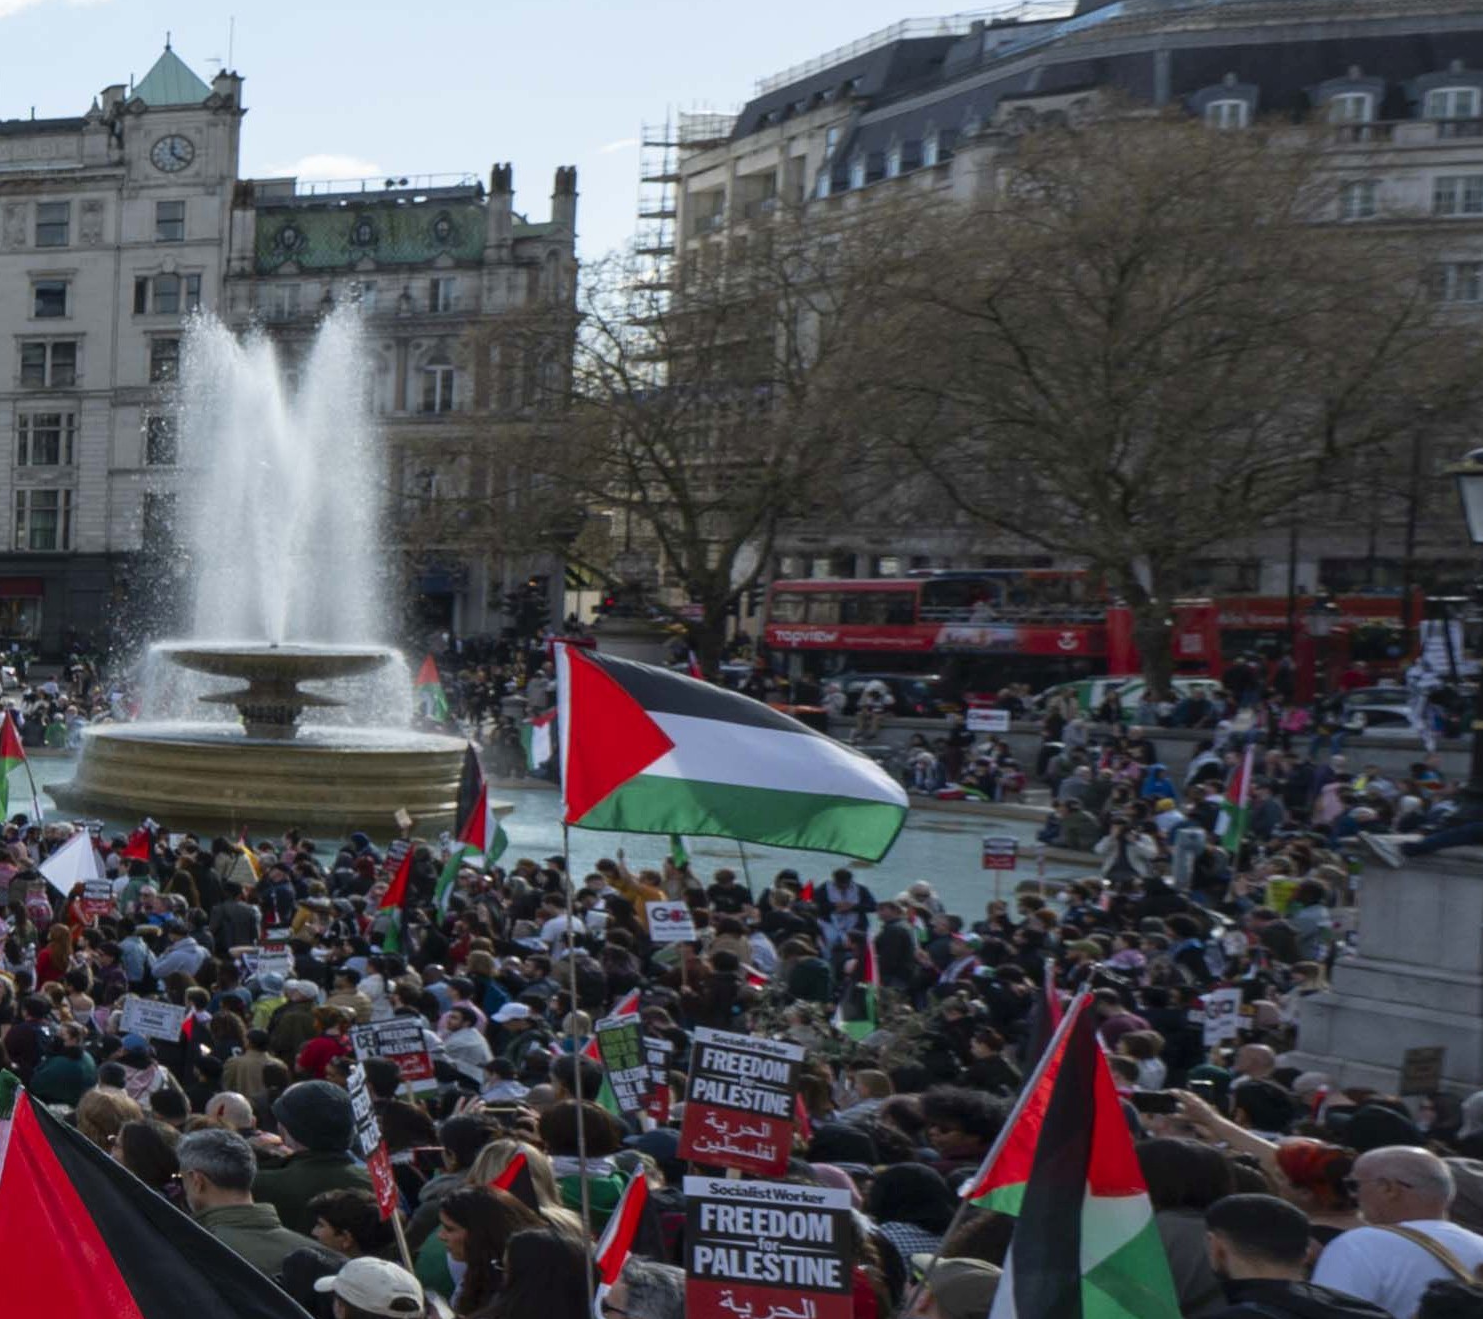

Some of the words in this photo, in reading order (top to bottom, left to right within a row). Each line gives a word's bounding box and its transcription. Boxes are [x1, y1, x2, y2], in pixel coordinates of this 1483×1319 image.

[702, 1048, 790, 1084] FREEDOM
[692, 1076, 791, 1117] PALESTINE
[699, 1202, 834, 1244] FREEDOM
[757, 1237, 780, 1254] for
[693, 1245, 843, 1288] PALESTINE
